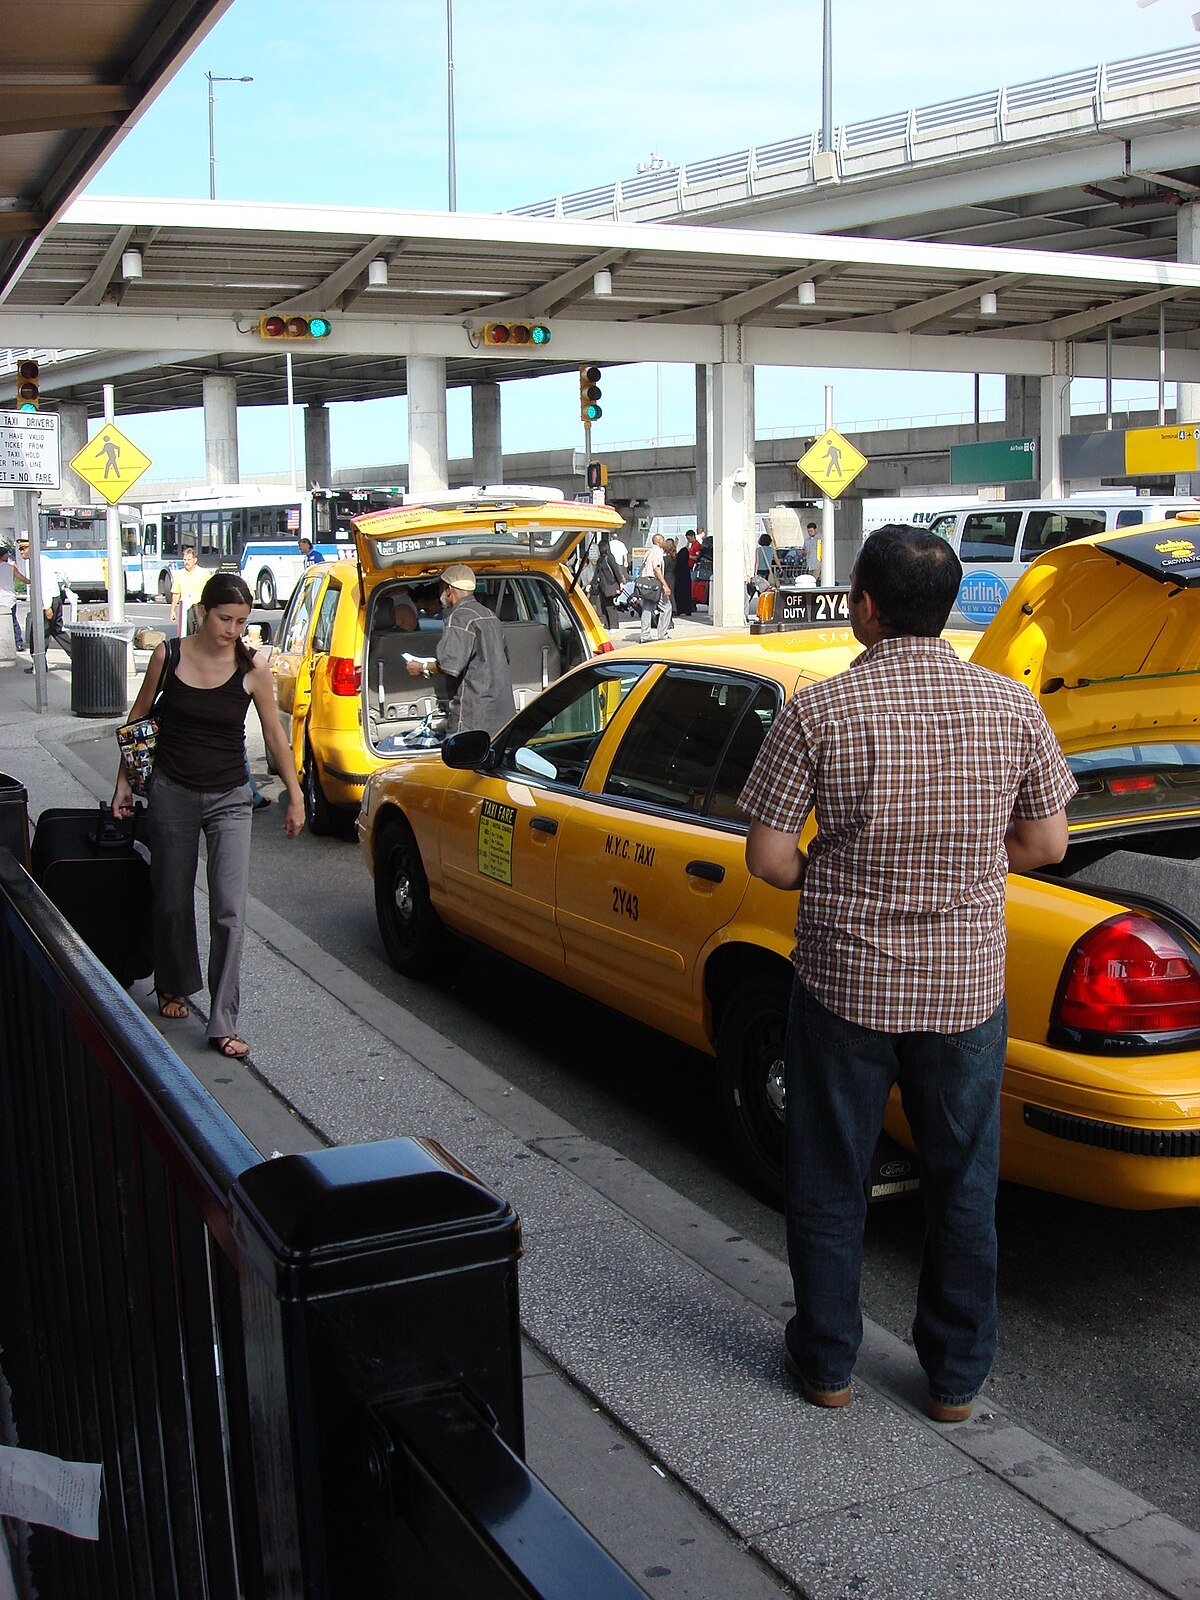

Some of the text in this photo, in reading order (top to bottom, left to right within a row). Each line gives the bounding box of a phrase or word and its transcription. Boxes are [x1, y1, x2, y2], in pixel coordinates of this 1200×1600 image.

[4, 416, 54, 428] TAXI DRIVERS
[19, 472, 28, 481] NO
[36, 473, 52, 482] FARE
[962, 582, 1002, 600] airlink
[784, 608, 806, 618] DUTY
[787, 594, 850, 620] OFF 2Y4
[484, 801, 498, 818] TAXI
[498, 806, 514, 824] FARE
[605, 835, 655, 867] N.Y.C. TAXI
[613, 886, 639, 921] 2Y43
